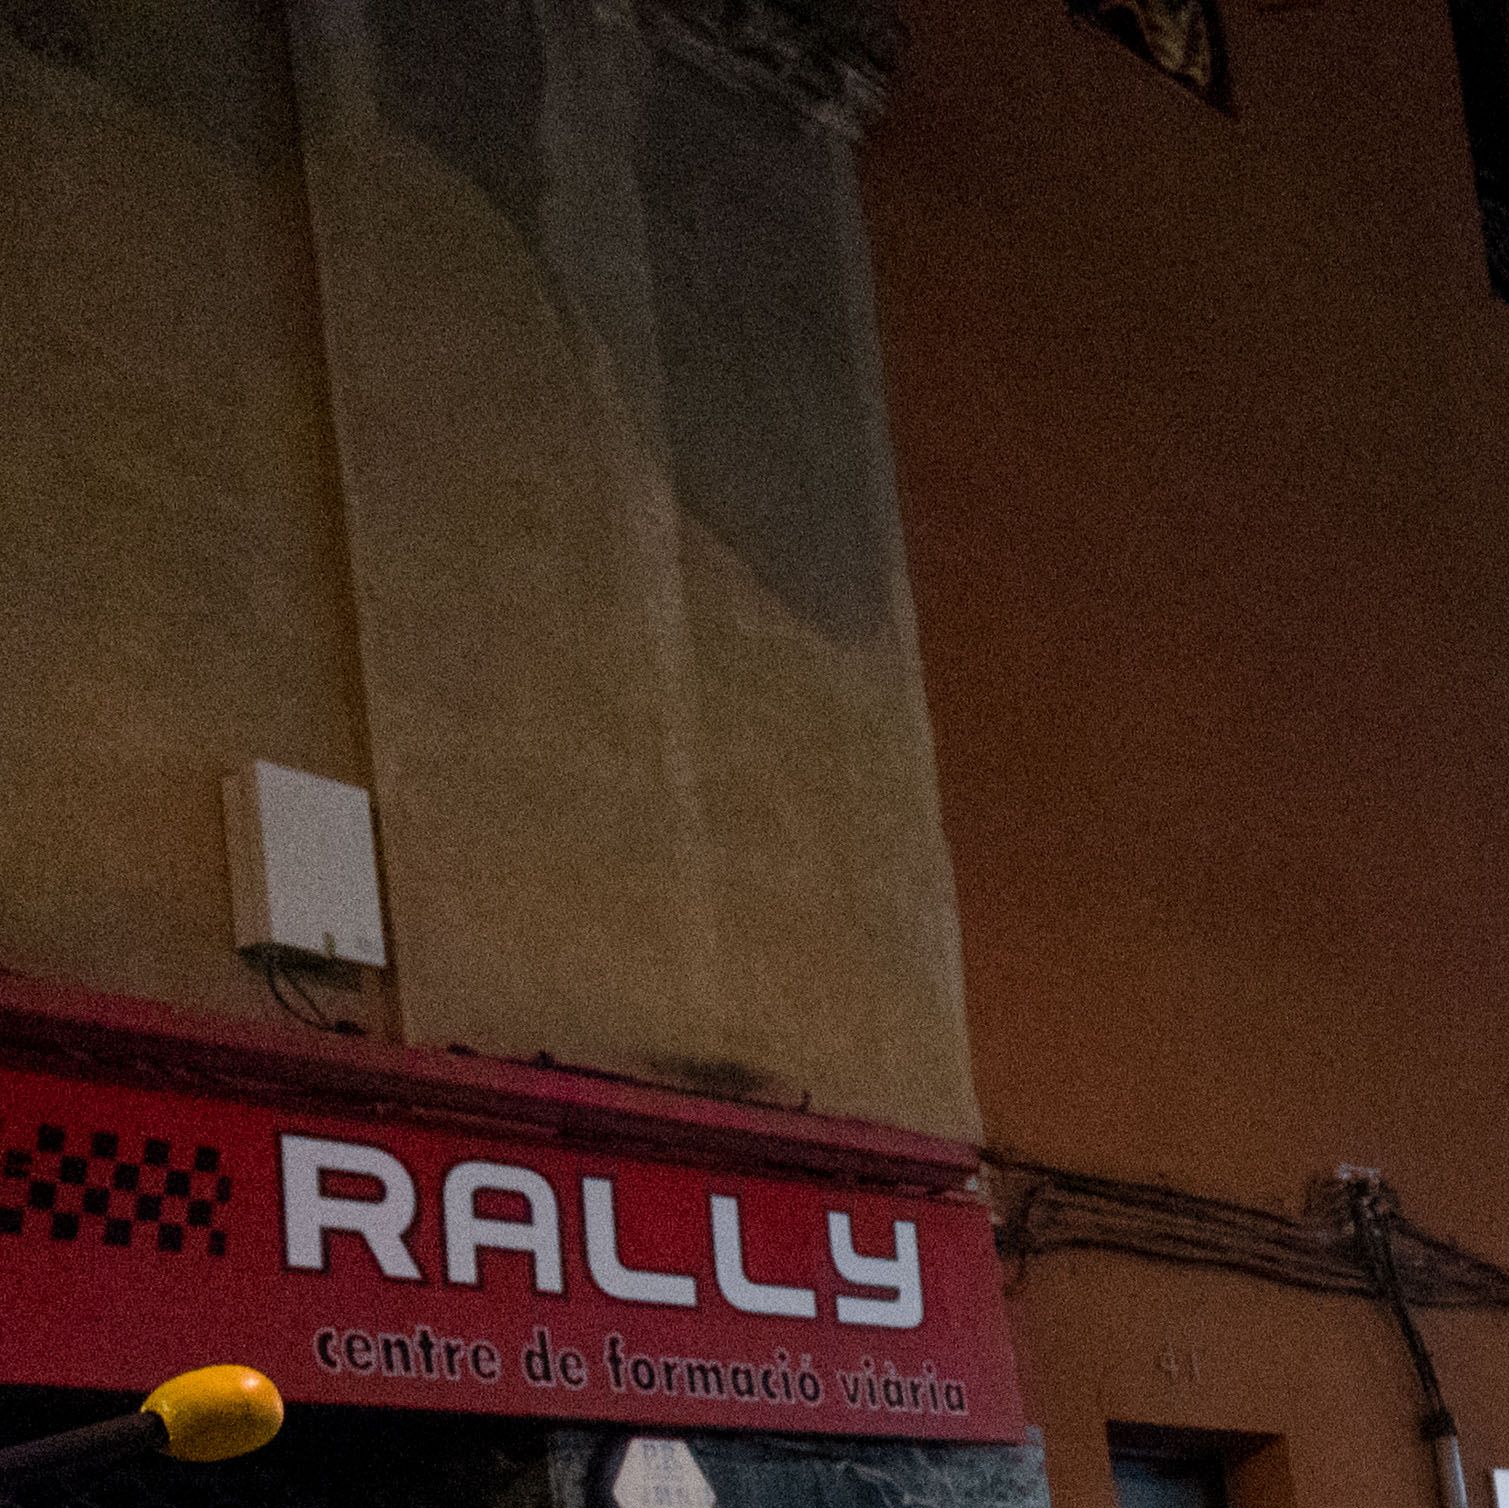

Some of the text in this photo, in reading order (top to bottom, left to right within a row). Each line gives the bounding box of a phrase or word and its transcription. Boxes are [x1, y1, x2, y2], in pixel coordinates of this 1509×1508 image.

[280, 1132, 924, 1329] RALLY
[313, 1326, 967, 1415] centre de formació viària
